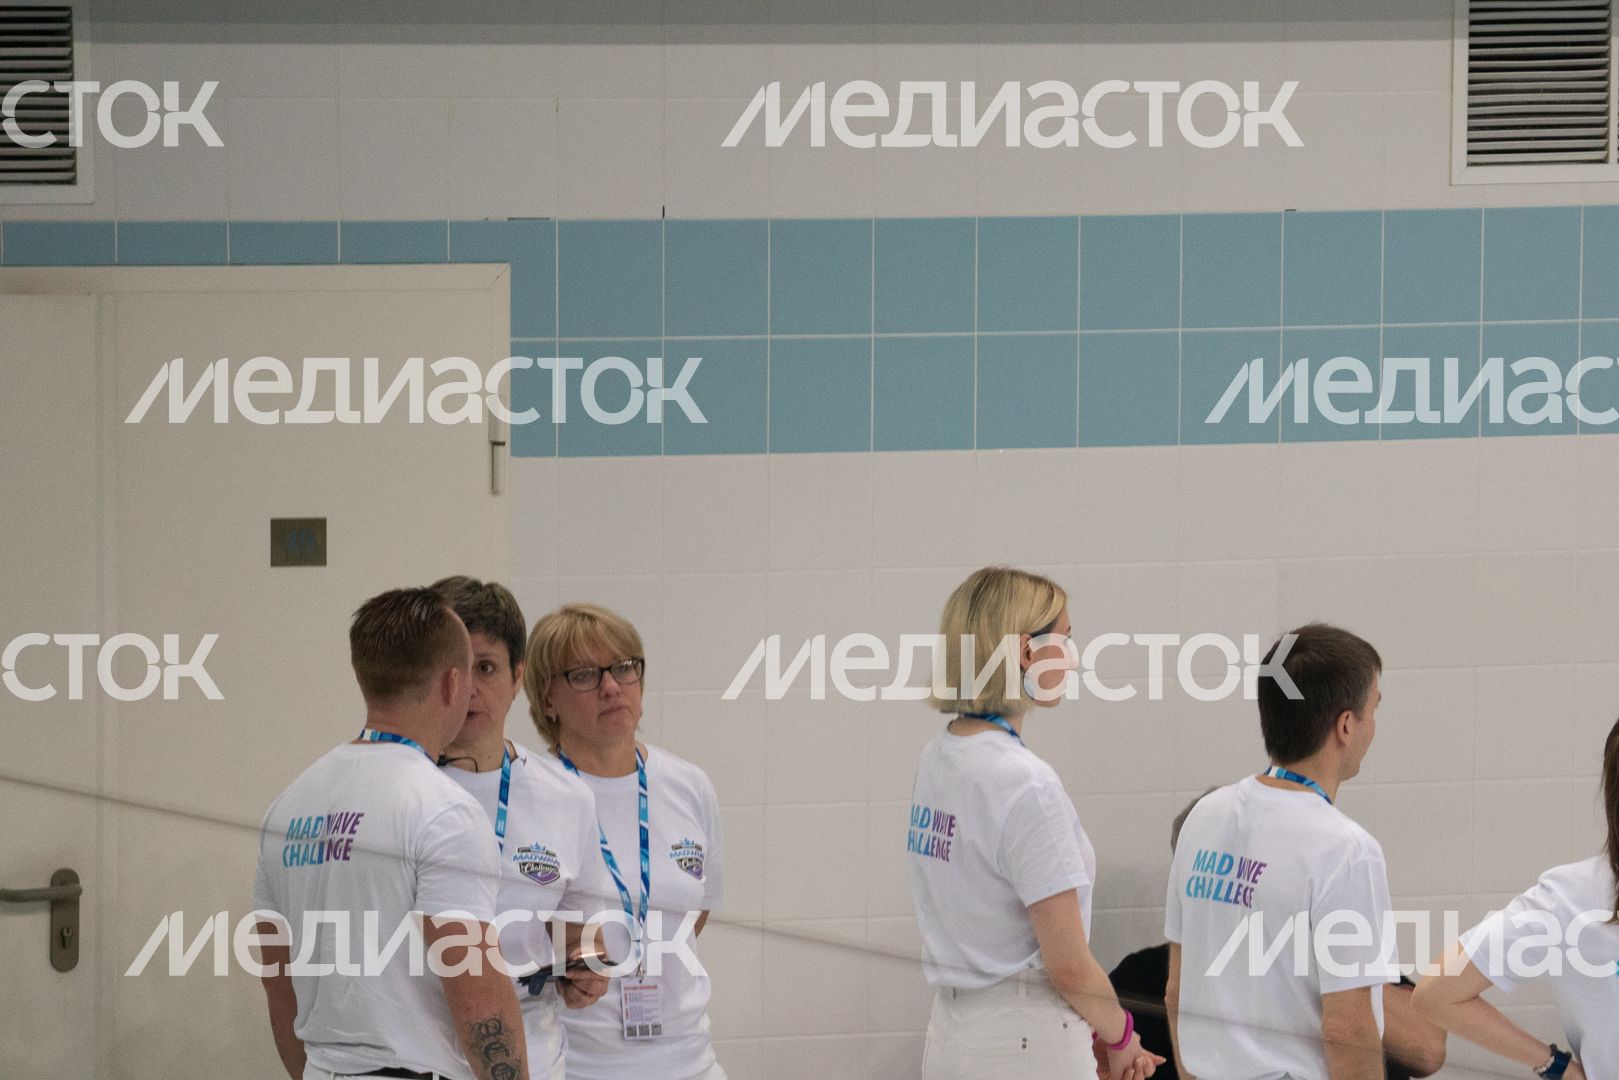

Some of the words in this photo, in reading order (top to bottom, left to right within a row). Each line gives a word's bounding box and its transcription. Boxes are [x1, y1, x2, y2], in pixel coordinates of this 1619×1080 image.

[286, 815, 324, 841] MAD
[282, 838, 354, 868] CHALLNGE
[907, 829, 952, 862] HALLENGE
[1192, 849, 1234, 876] MAD
[1237, 856, 1267, 885] WVE
[1185, 875, 1254, 909] CHALLEGE
